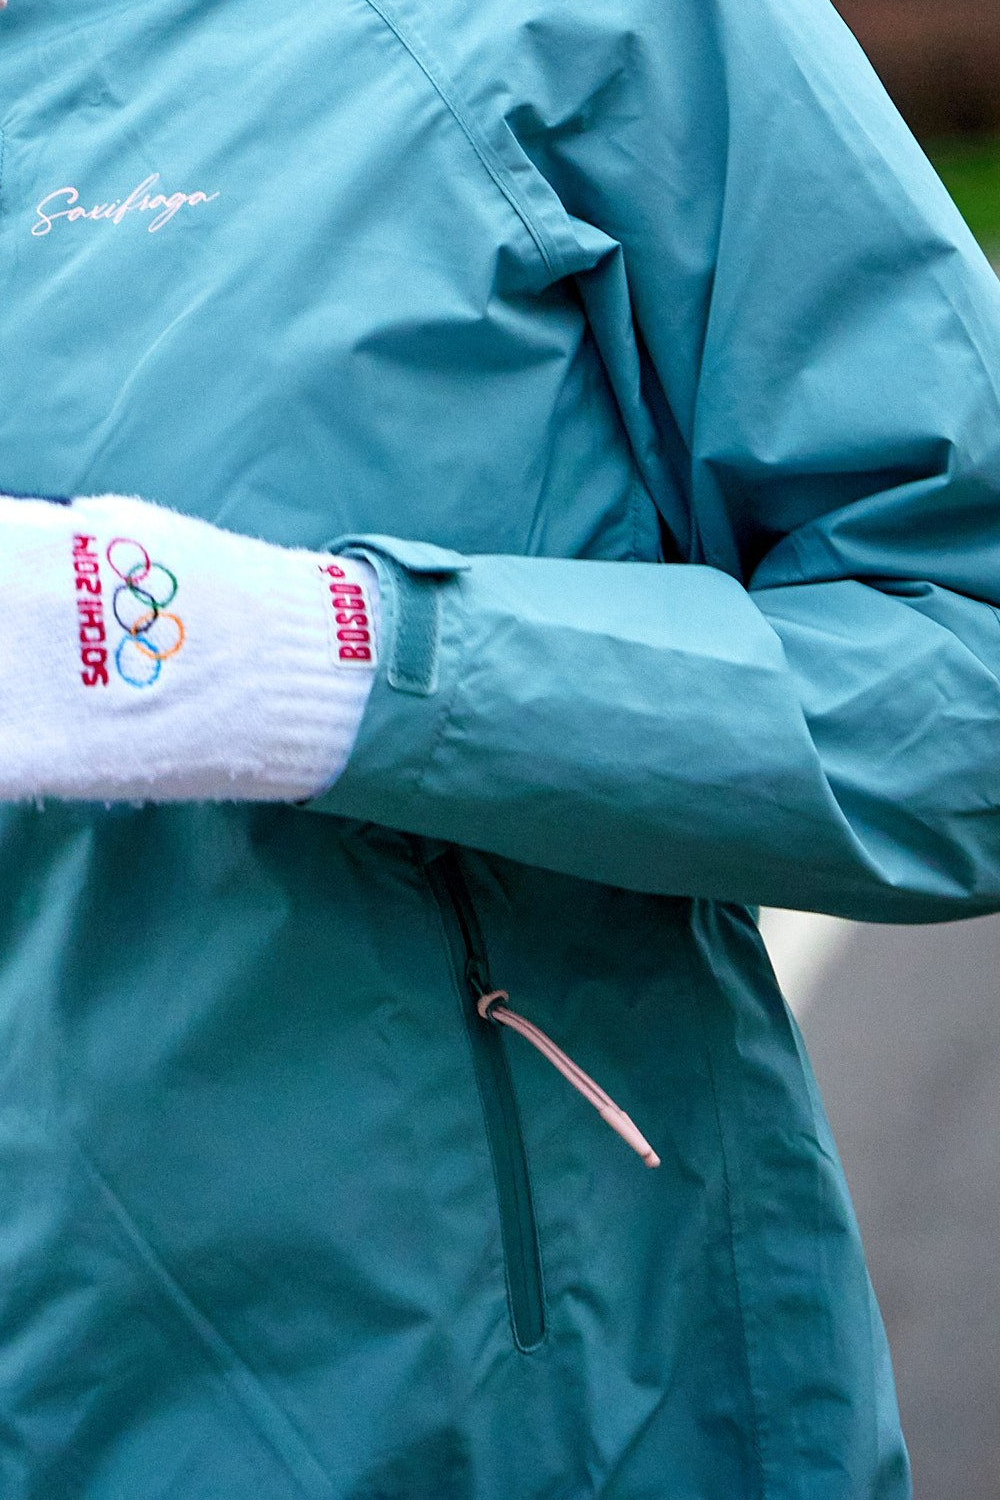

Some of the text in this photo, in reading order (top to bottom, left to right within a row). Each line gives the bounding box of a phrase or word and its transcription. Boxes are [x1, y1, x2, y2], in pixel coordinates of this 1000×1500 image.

[72, 534, 109, 687] SOCHI 2014
[329, 583, 372, 662] BOSCO
